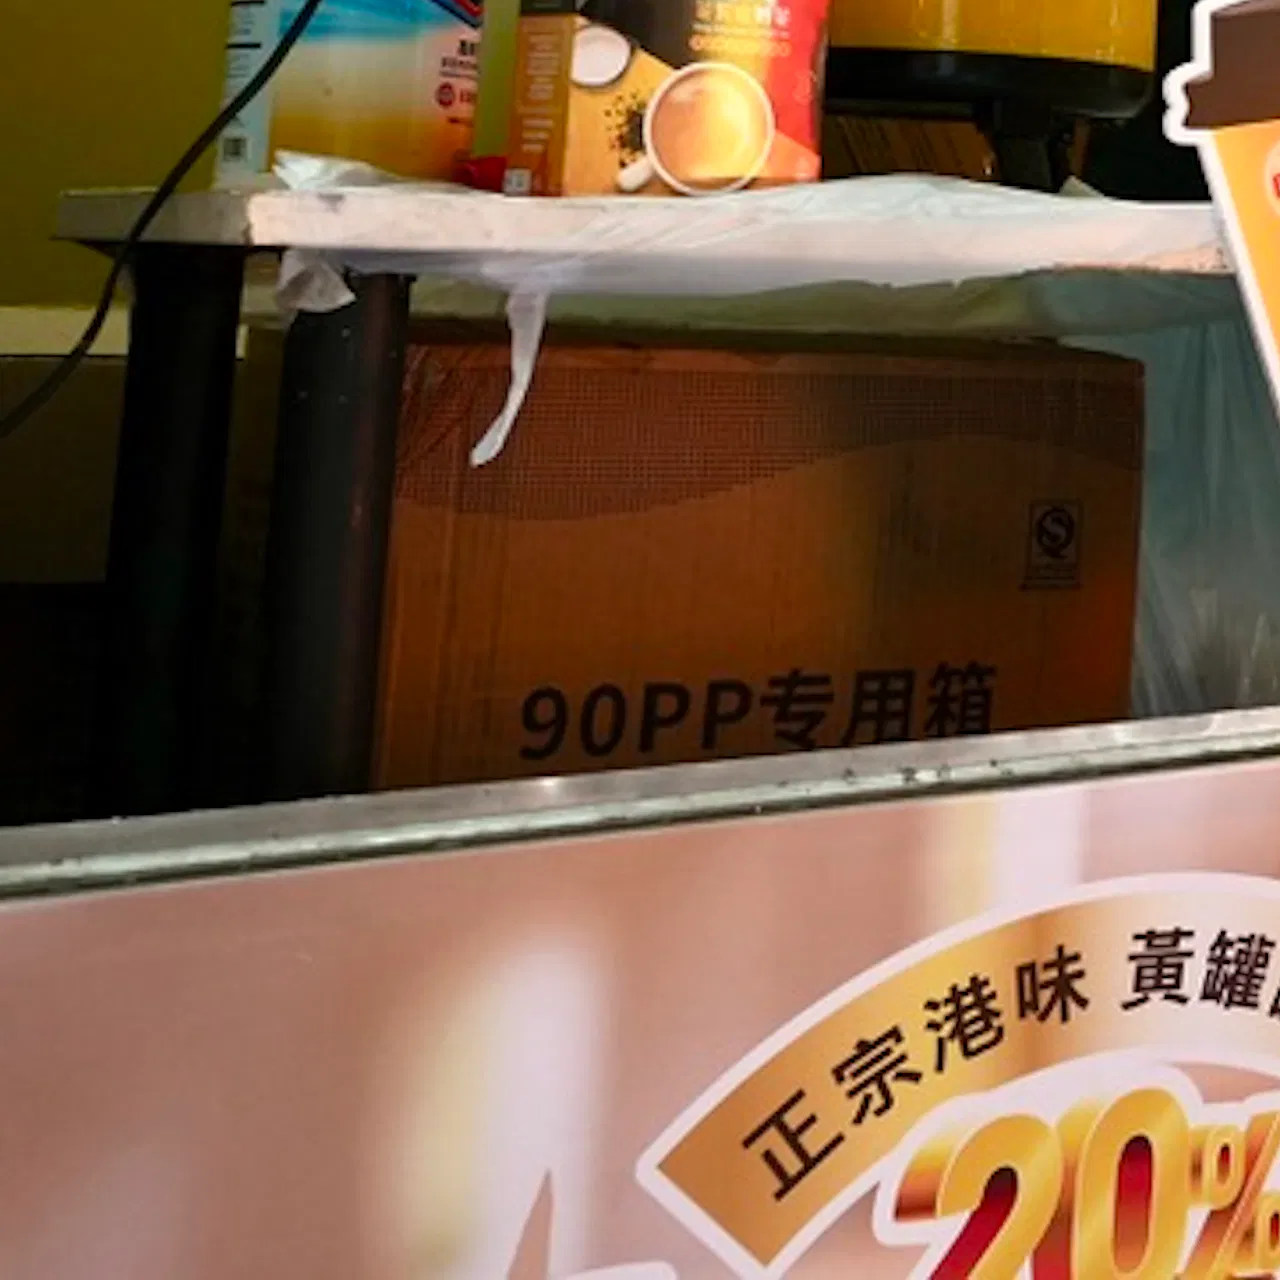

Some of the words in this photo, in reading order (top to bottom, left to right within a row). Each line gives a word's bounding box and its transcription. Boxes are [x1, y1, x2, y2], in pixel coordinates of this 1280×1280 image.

[518, 660, 996, 761] 90PP专用箱
[739, 941, 1092, 1205] 正宗港味
